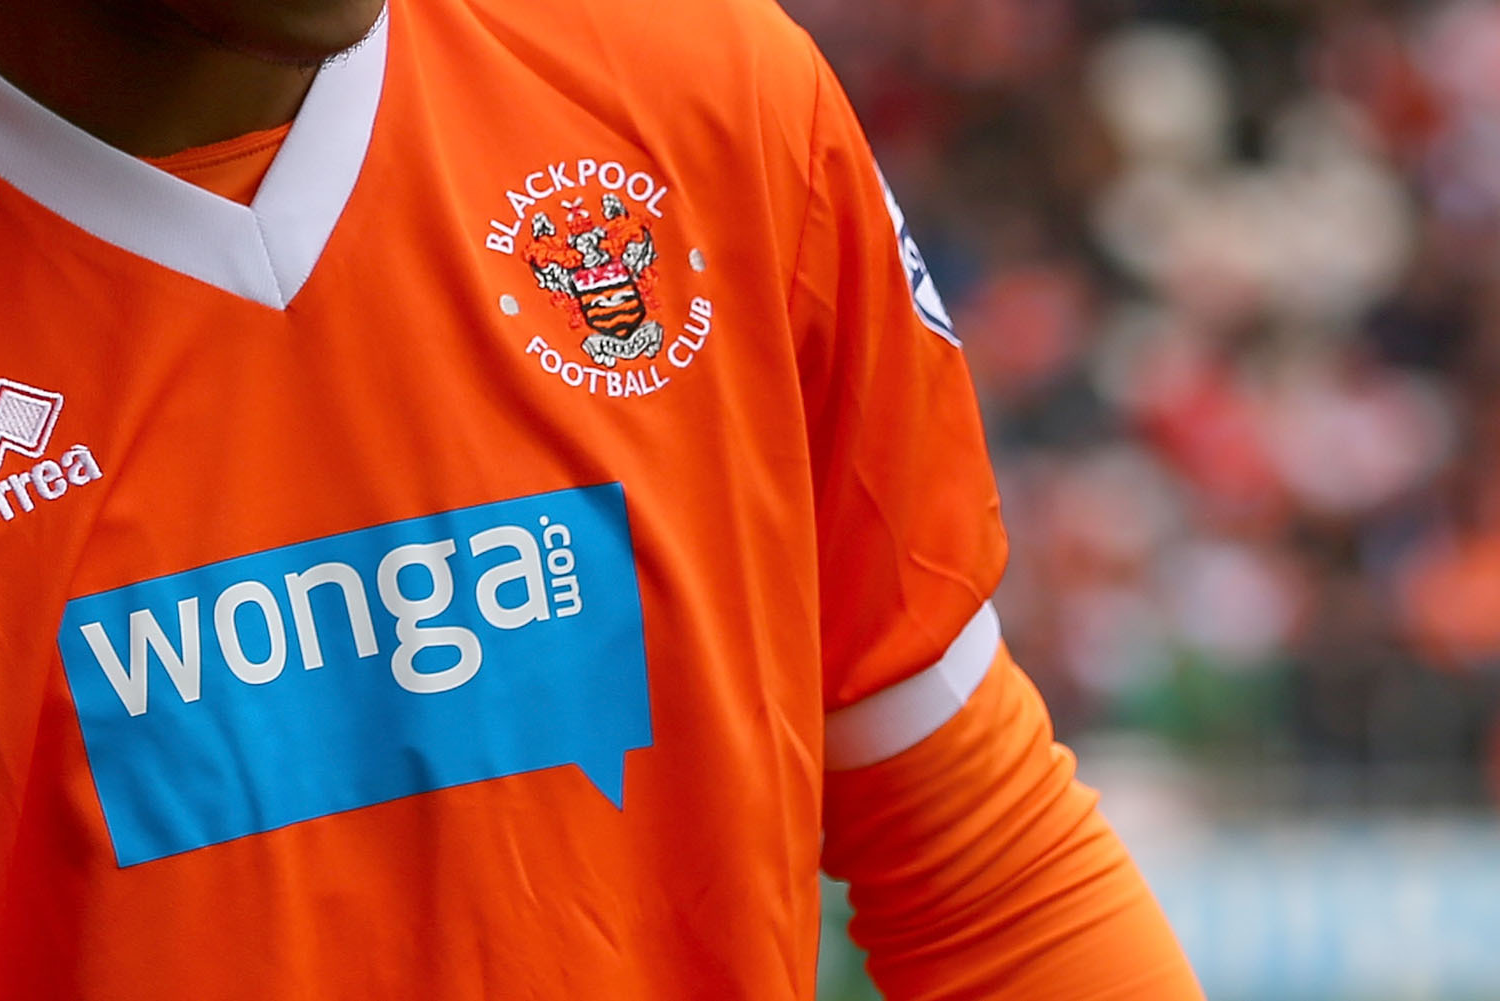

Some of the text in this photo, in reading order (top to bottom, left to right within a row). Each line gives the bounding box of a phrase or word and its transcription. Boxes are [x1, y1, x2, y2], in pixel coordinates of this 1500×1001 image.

[485, 158, 668, 255] BLACKPOOL
[525, 335, 670, 398] FOOTBALL
[667, 296, 712, 368] CLUB
[79, 515, 583, 718] wonga .com
